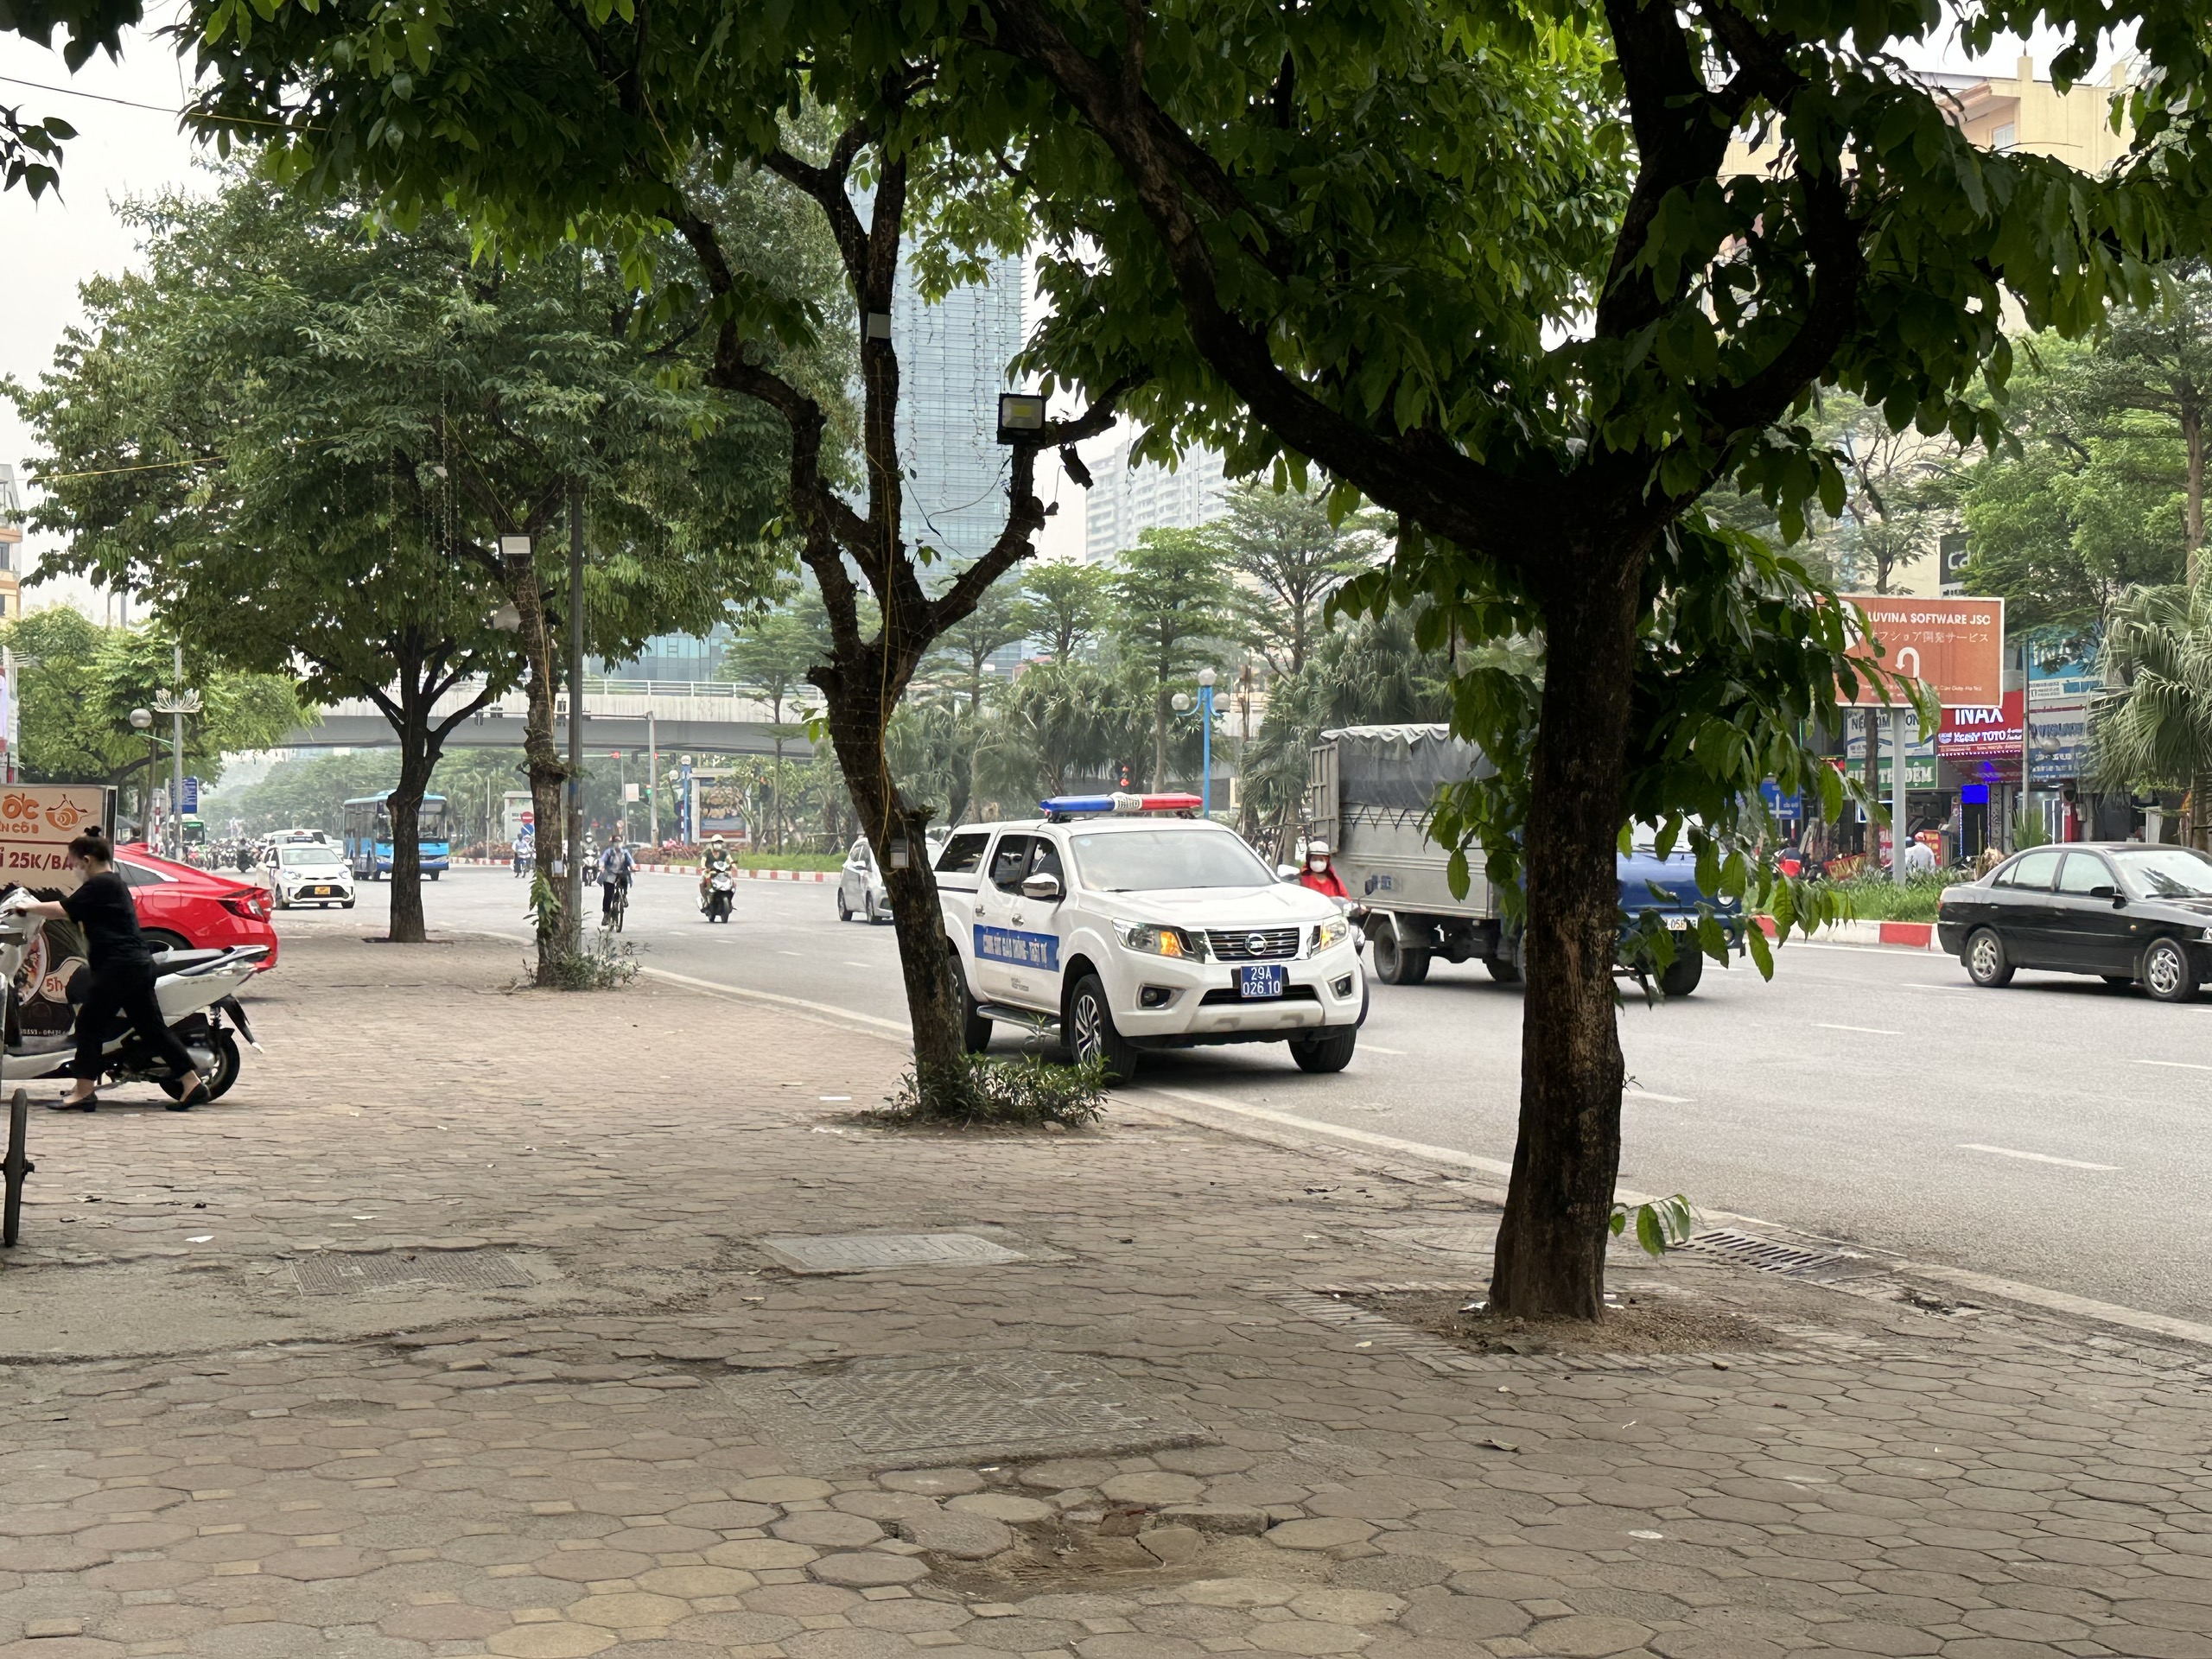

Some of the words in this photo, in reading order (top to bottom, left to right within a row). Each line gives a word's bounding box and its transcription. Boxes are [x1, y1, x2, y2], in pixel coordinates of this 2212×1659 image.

[1868, 611, 1908, 624] LUVINA
[1910, 613, 1967, 625] SOFTWARE
[1969, 614, 1991, 625] JSC
[1981, 730, 2006, 742] TOTO
[1250, 965, 1273, 981] 29A
[1243, 980, 1281, 995] 026.10
